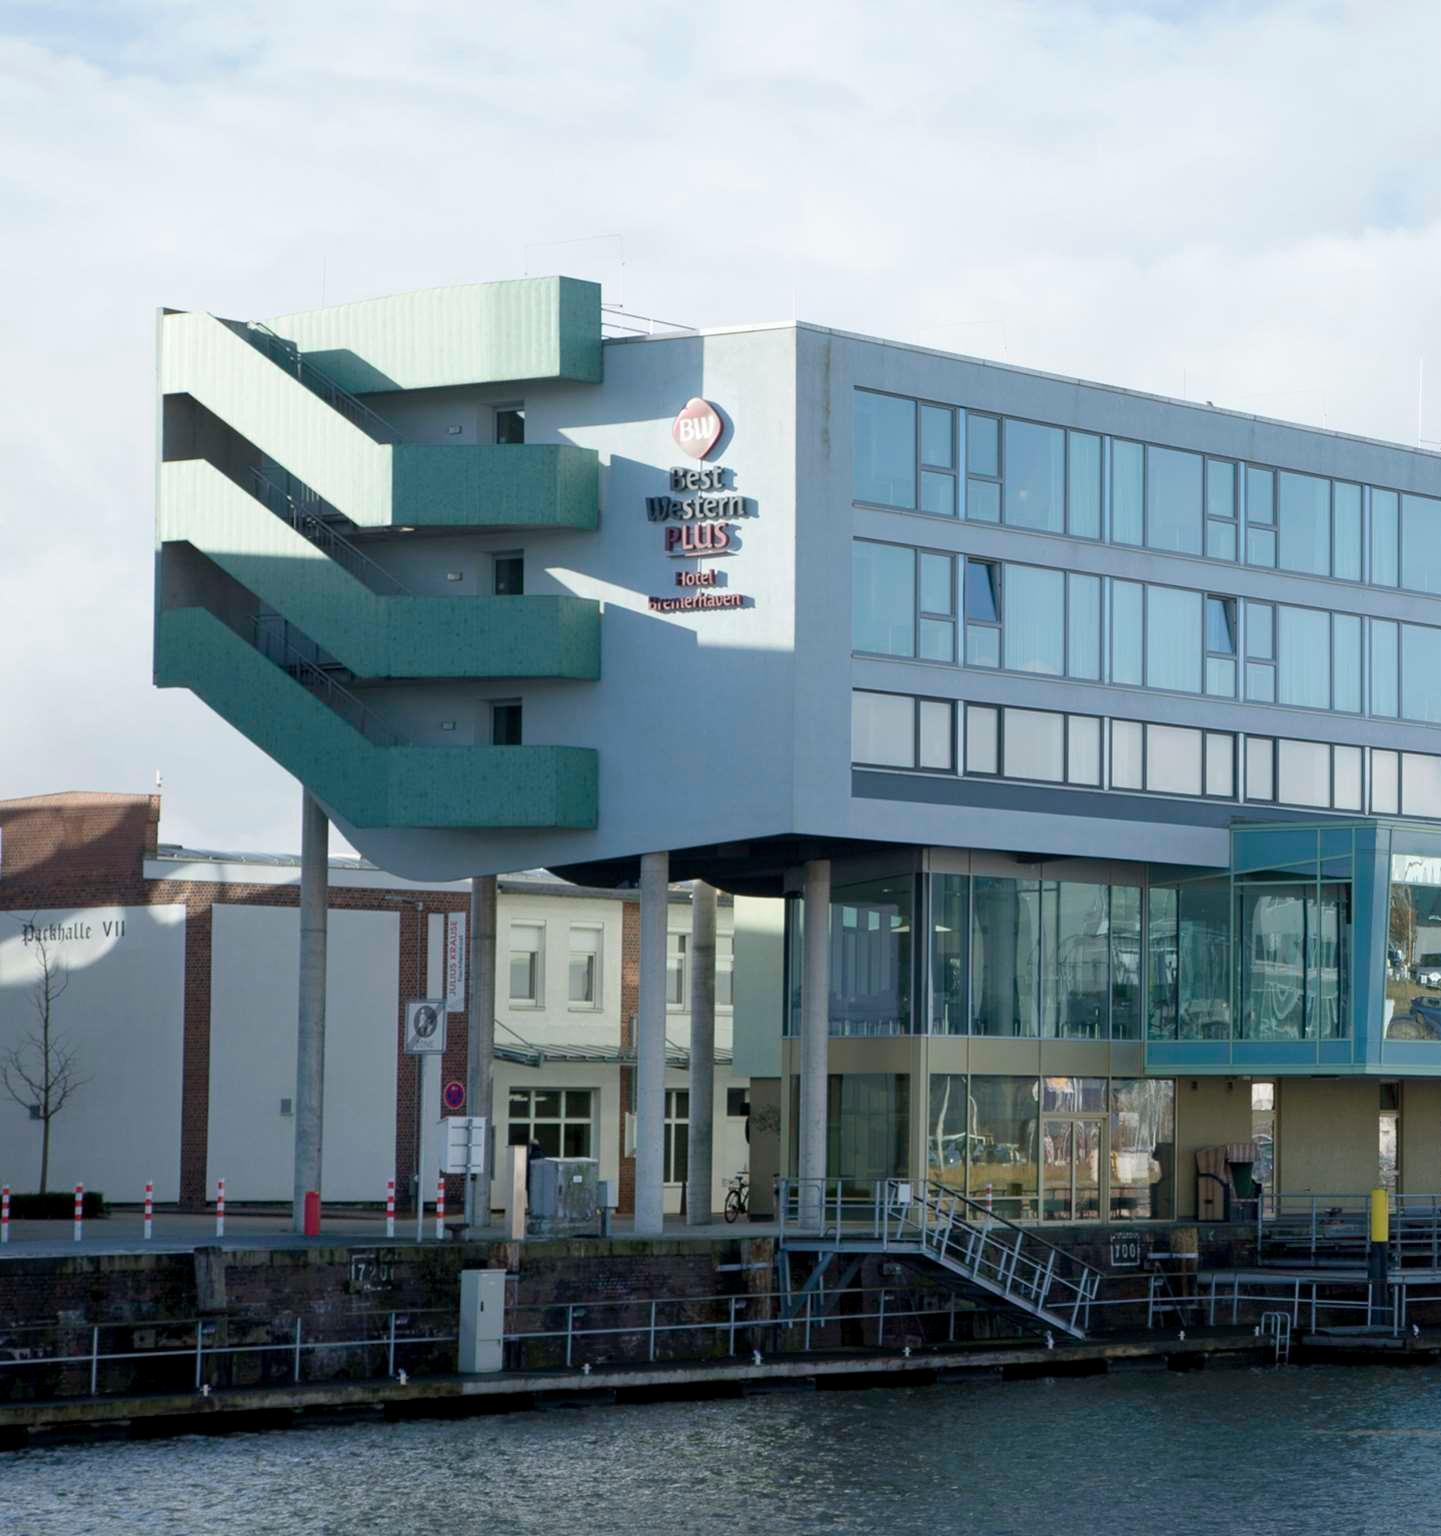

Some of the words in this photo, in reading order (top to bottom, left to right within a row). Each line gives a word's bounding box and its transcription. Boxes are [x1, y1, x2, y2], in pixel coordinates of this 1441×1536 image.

[679, 413, 716, 442] BW
[670, 465, 723, 492] Best
[645, 496, 745, 522] Western
[665, 522, 730, 552] PLUS
[675, 569, 716, 587] Hotel
[648, 592, 743, 612] Bremerhaven
[22, 922, 91, 946] Packhalle
[103, 920, 125, 937] VII
